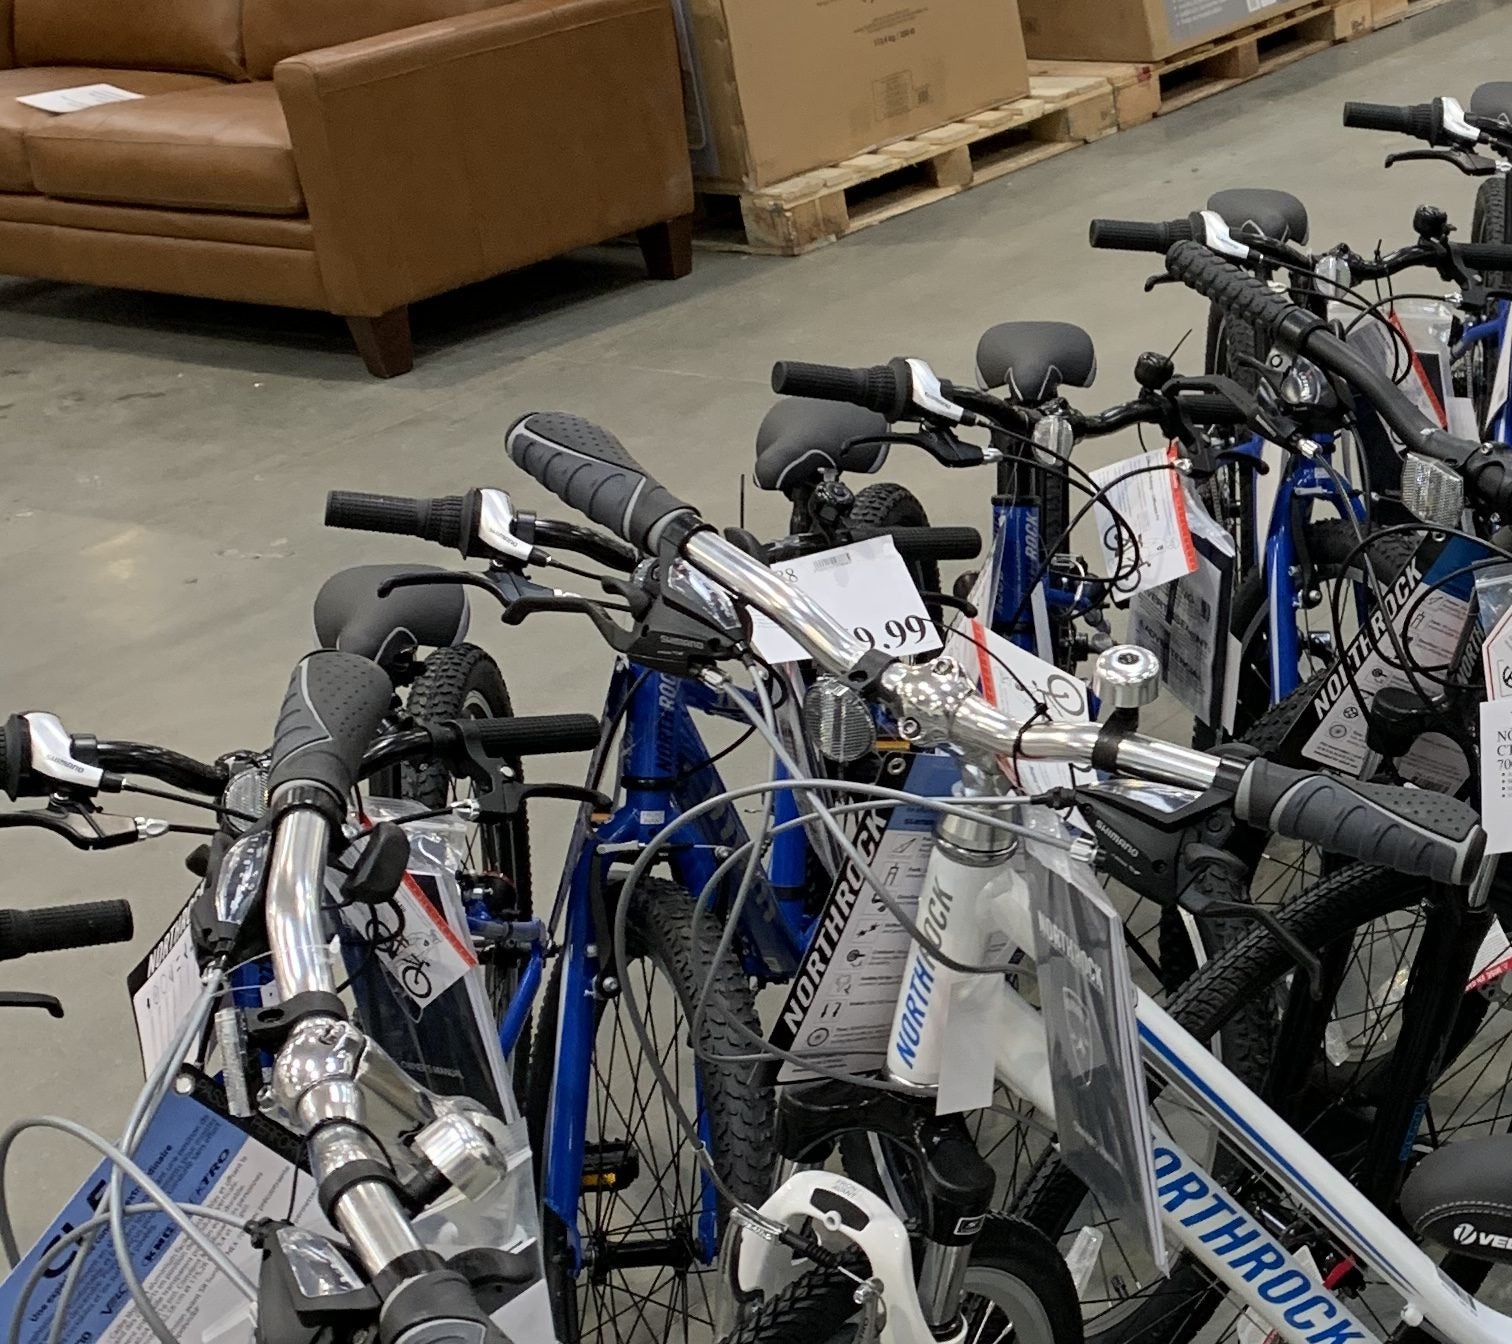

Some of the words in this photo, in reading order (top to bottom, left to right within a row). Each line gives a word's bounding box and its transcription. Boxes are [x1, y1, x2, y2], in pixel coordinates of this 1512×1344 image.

[853, 614, 928, 653] 9.99
[1456, 617, 1487, 686] NORTH
[46, 754, 84, 774] SHIMANO
[1096, 819, 1140, 858] SHIMANO
[783, 808, 889, 1037] NORTHROCK
